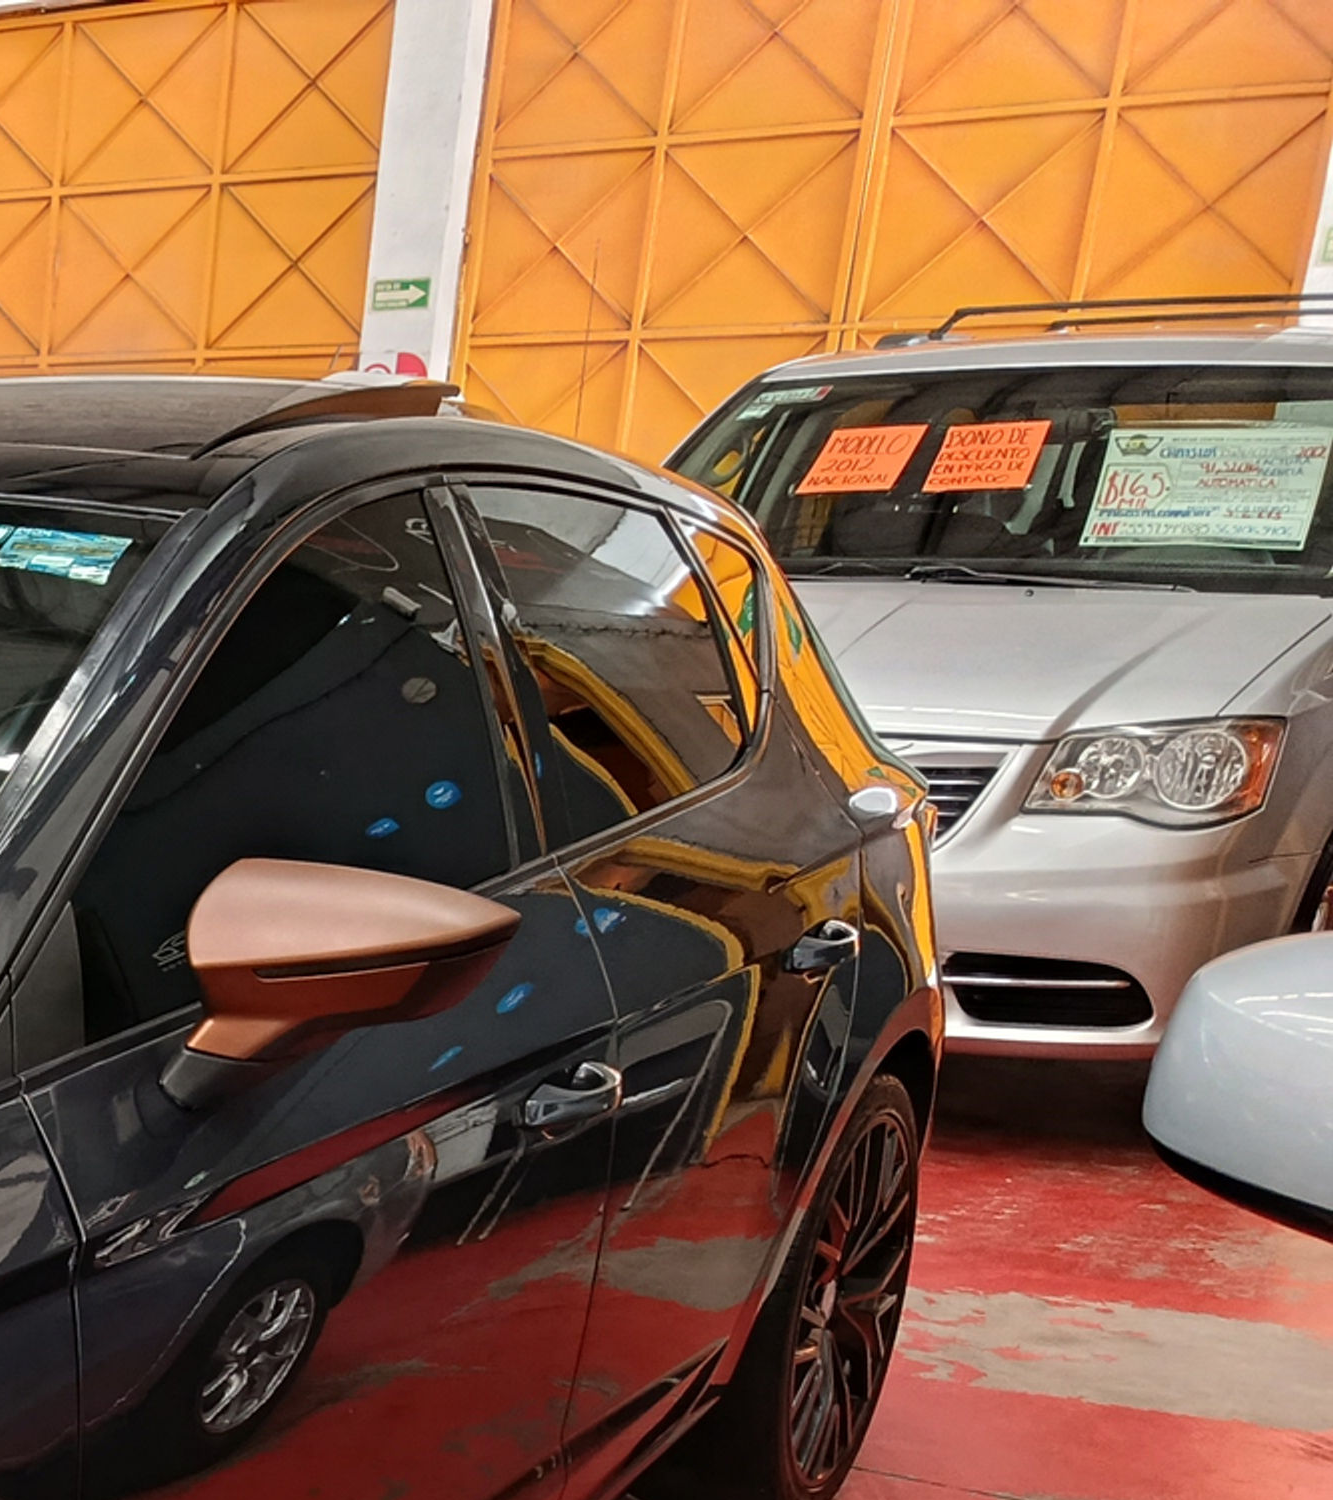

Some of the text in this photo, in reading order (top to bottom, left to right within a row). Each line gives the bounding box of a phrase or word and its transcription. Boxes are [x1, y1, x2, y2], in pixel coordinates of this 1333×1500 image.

[946, 428, 1033, 448] BONO DE
[939, 448, 1031, 462] DESCUENTO
[821, 458, 874, 472] 2012
[807, 474, 888, 486] NACIONAL
[929, 473, 1008, 485] CONTADO
[1098, 471, 1165, 506] $165
